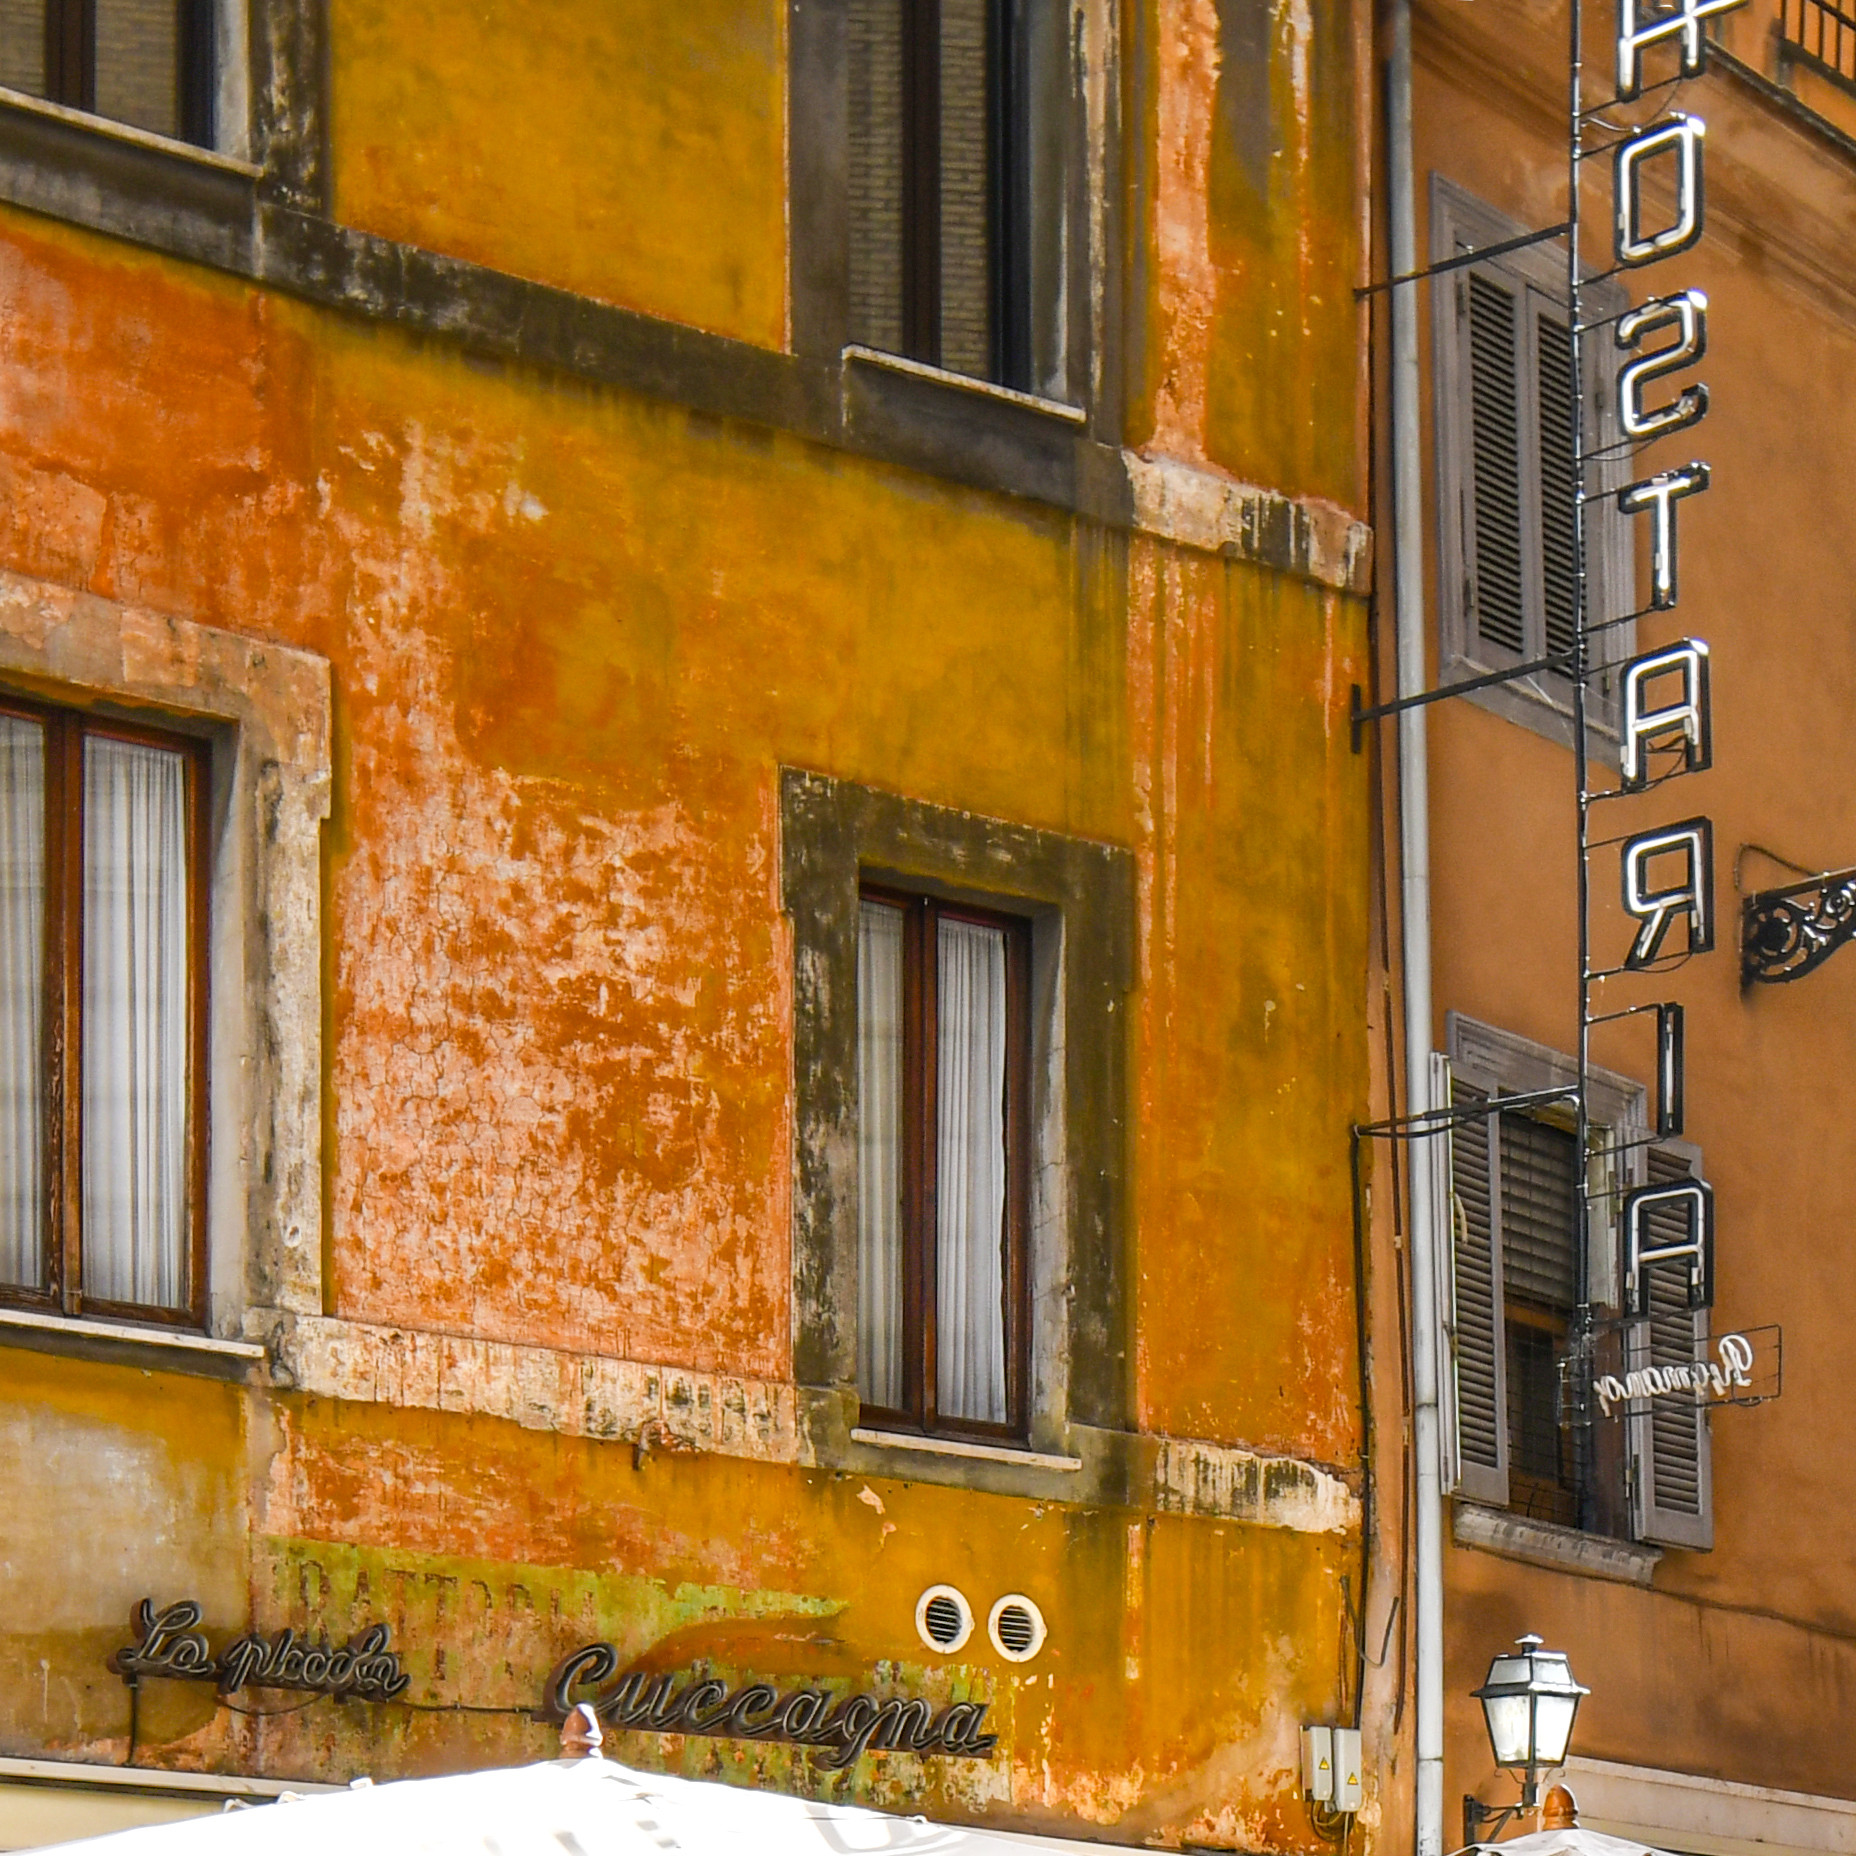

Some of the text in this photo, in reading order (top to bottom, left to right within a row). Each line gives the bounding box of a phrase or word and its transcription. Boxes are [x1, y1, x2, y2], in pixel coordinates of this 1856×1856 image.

[109, 1597, 1000, 1771] La piccola Cuccagna
